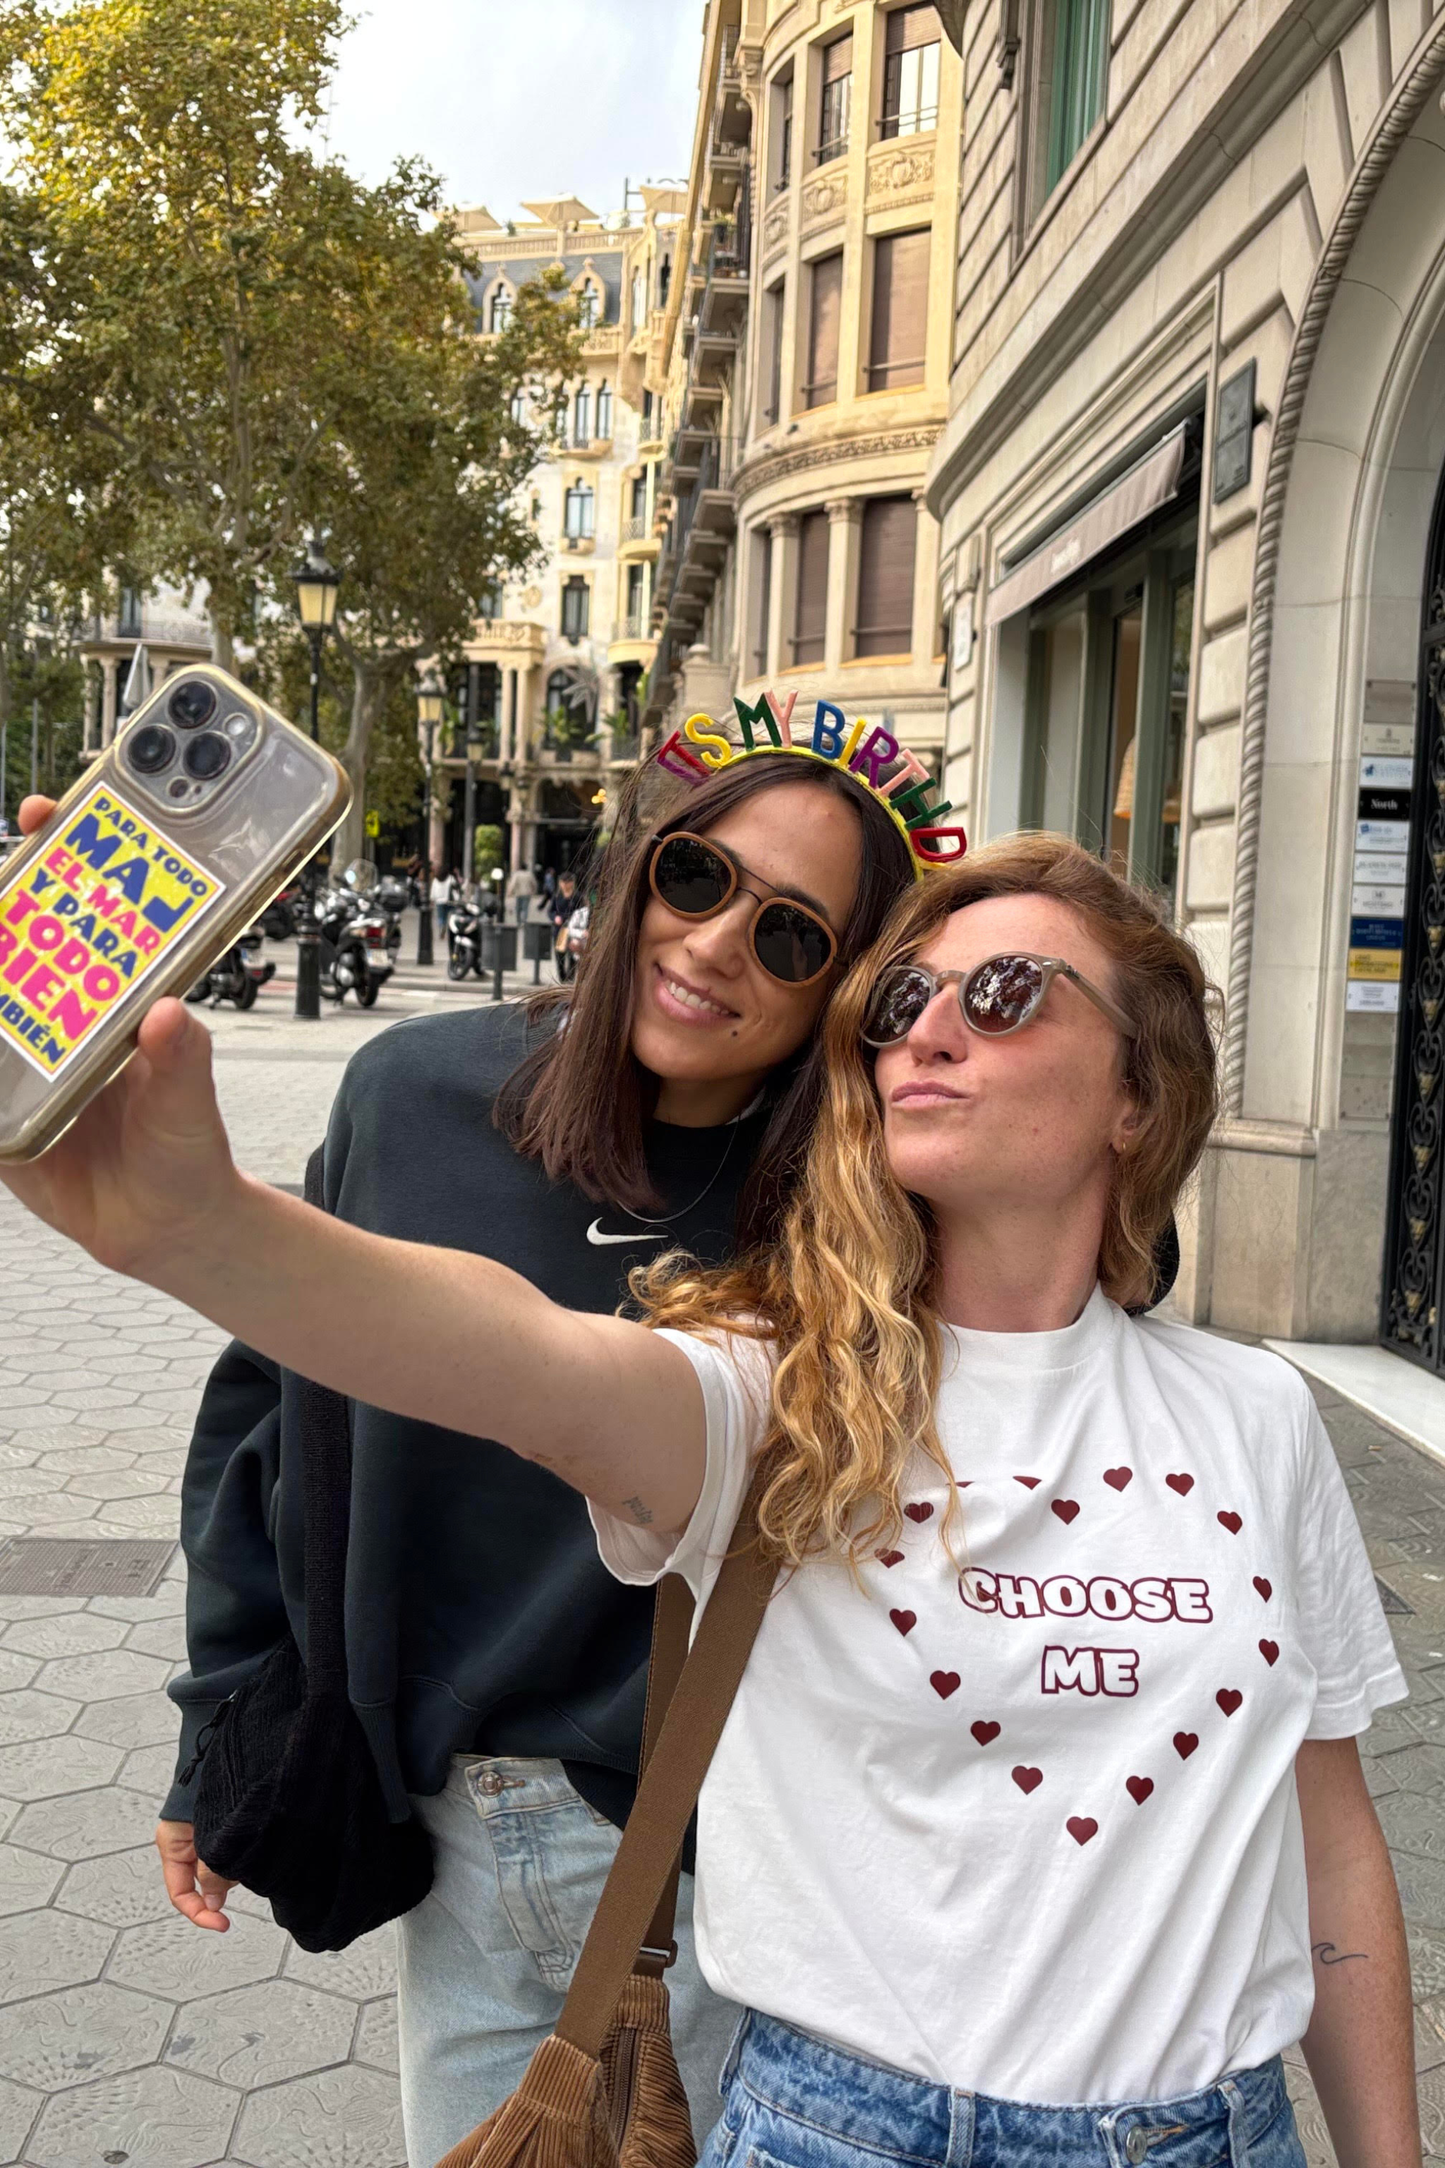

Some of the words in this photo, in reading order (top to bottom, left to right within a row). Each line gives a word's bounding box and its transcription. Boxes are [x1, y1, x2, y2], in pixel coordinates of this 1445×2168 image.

[733, 689, 798, 753] MY
[811, 699, 968, 868] BIRTHD
[1371, 798, 1398, 811] North
[93, 797, 149, 849] PARA
[152, 845, 208, 897] TODO
[5, 889, 121, 1001] TODO
[30, 868, 57, 895] Y
[52, 892, 138, 979] PARA
[45, 847, 85, 892] EL
[87, 884, 162, 956] MAR
[958, 1567, 1214, 1624] CHOOSE
[1041, 1645, 1140, 1698] ME
